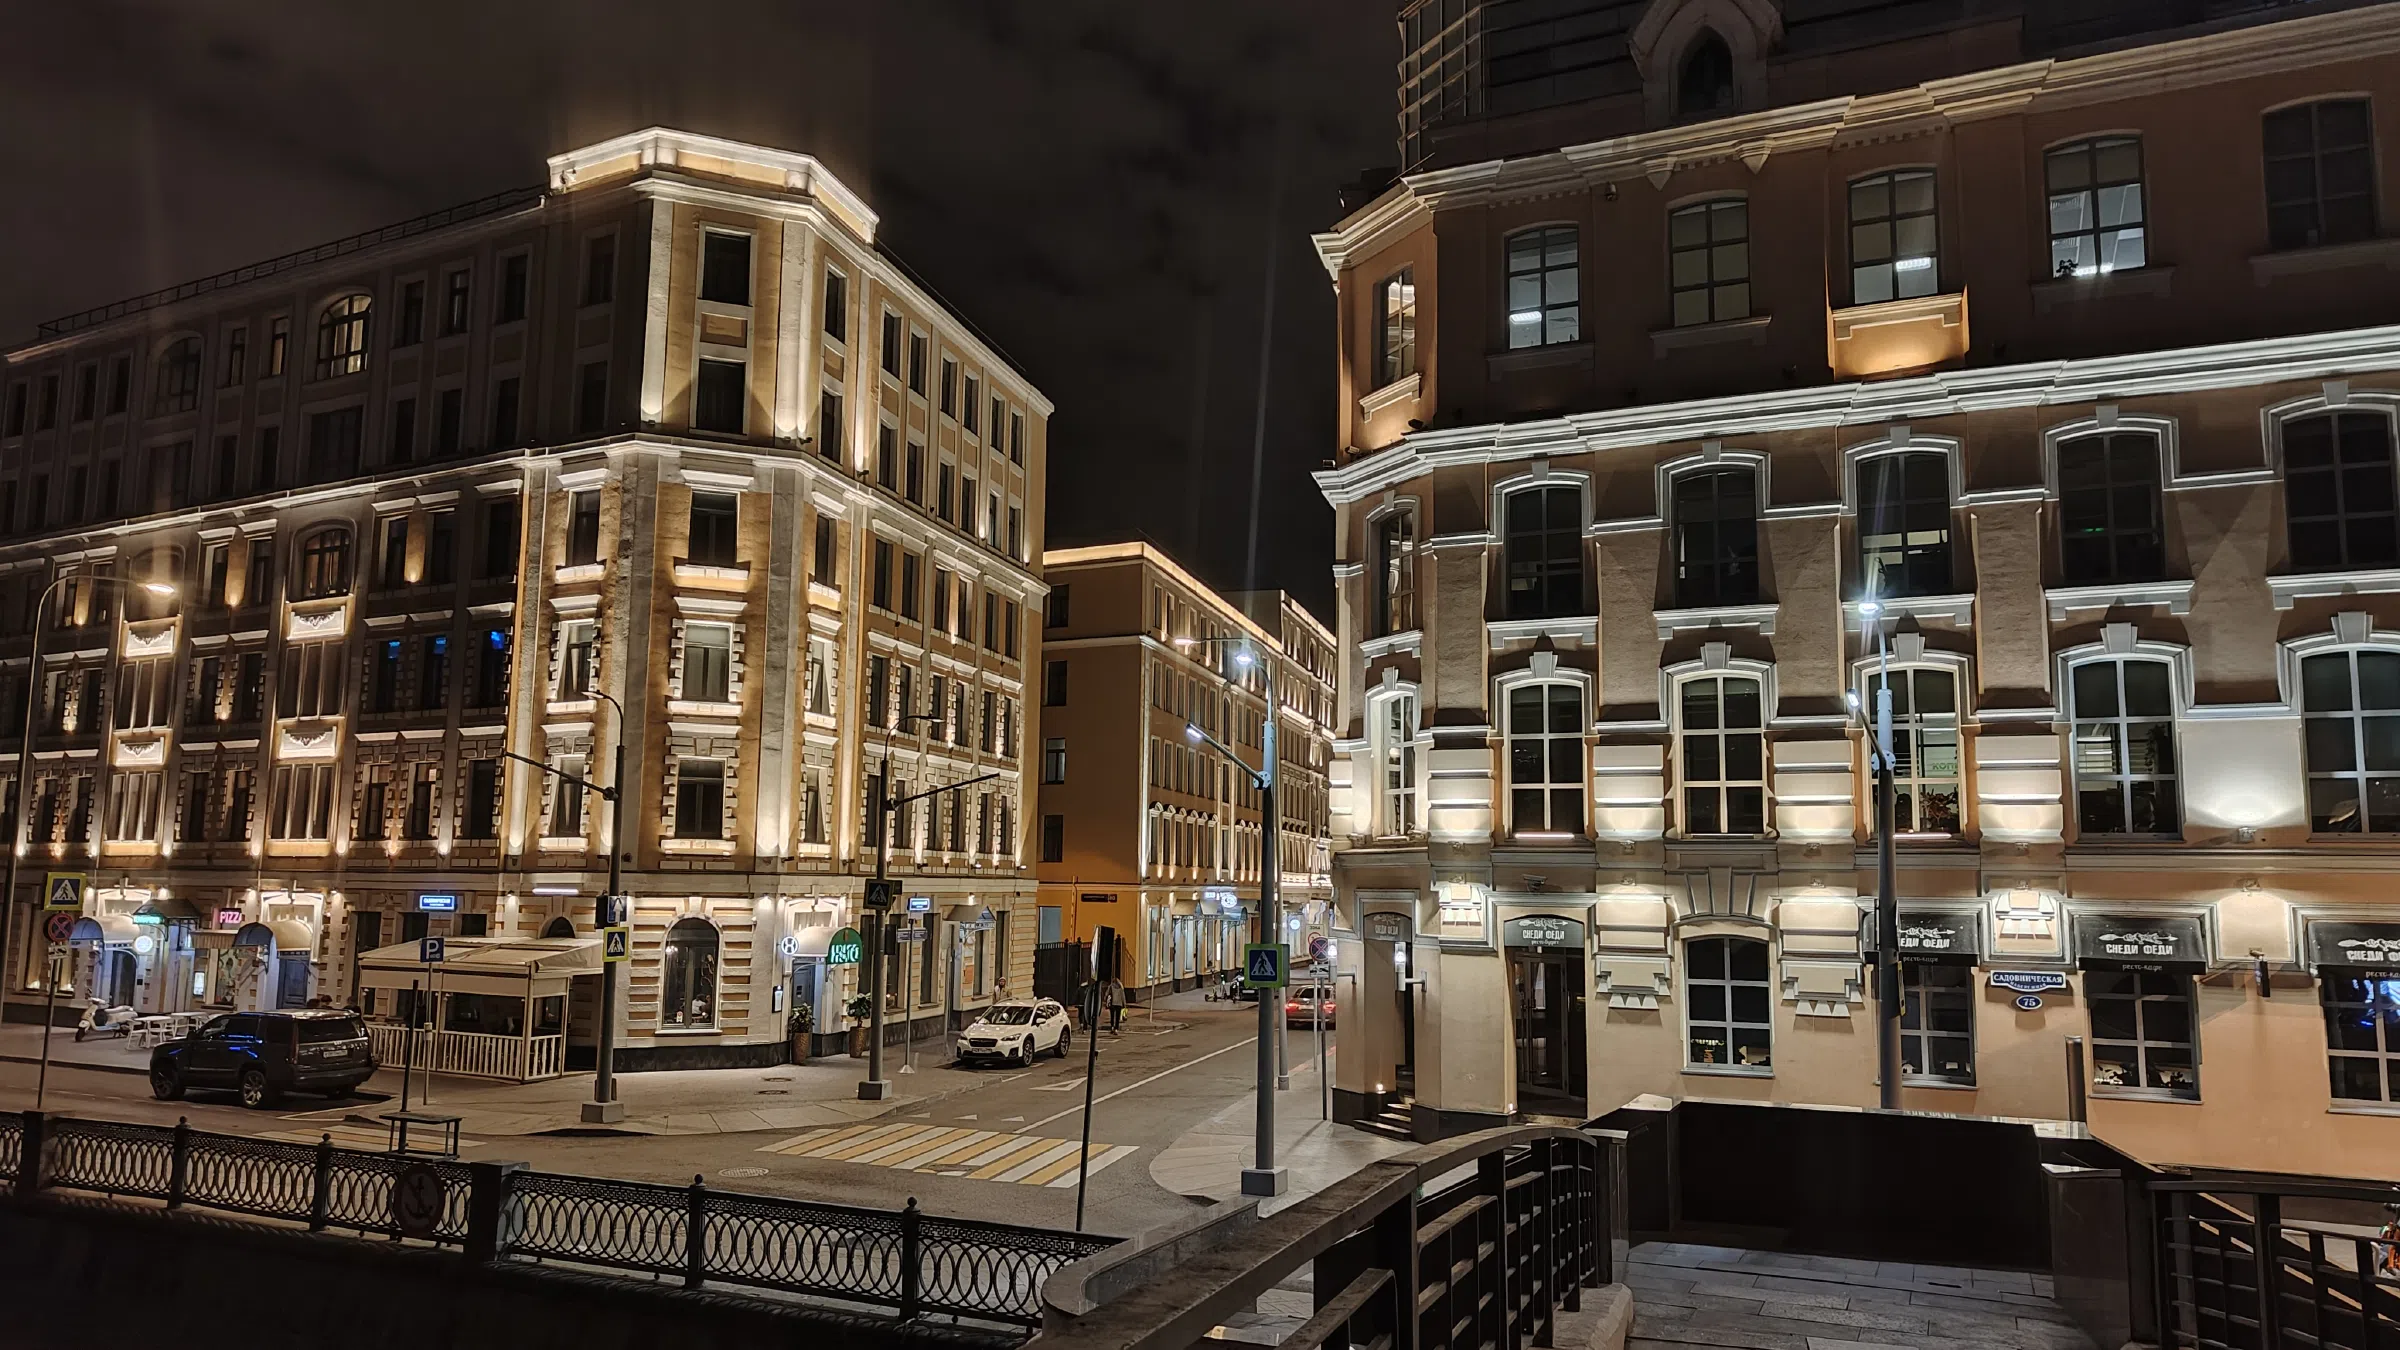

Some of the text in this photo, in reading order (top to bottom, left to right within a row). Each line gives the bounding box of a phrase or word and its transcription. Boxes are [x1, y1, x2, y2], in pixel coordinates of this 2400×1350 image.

[1522, 930, 1565, 940] СНЕДИ ФЕДИ
[1922, 938, 1951, 949] ФЕДИ
[2106, 944, 2173, 955] СНЕДИ ФЕДИ
[2346, 950, 2384, 961] СНЕДИ
[1993, 974, 2063, 983] САДОВНИЧЕСКАЯ
[2023, 998, 2036, 1006] 75
